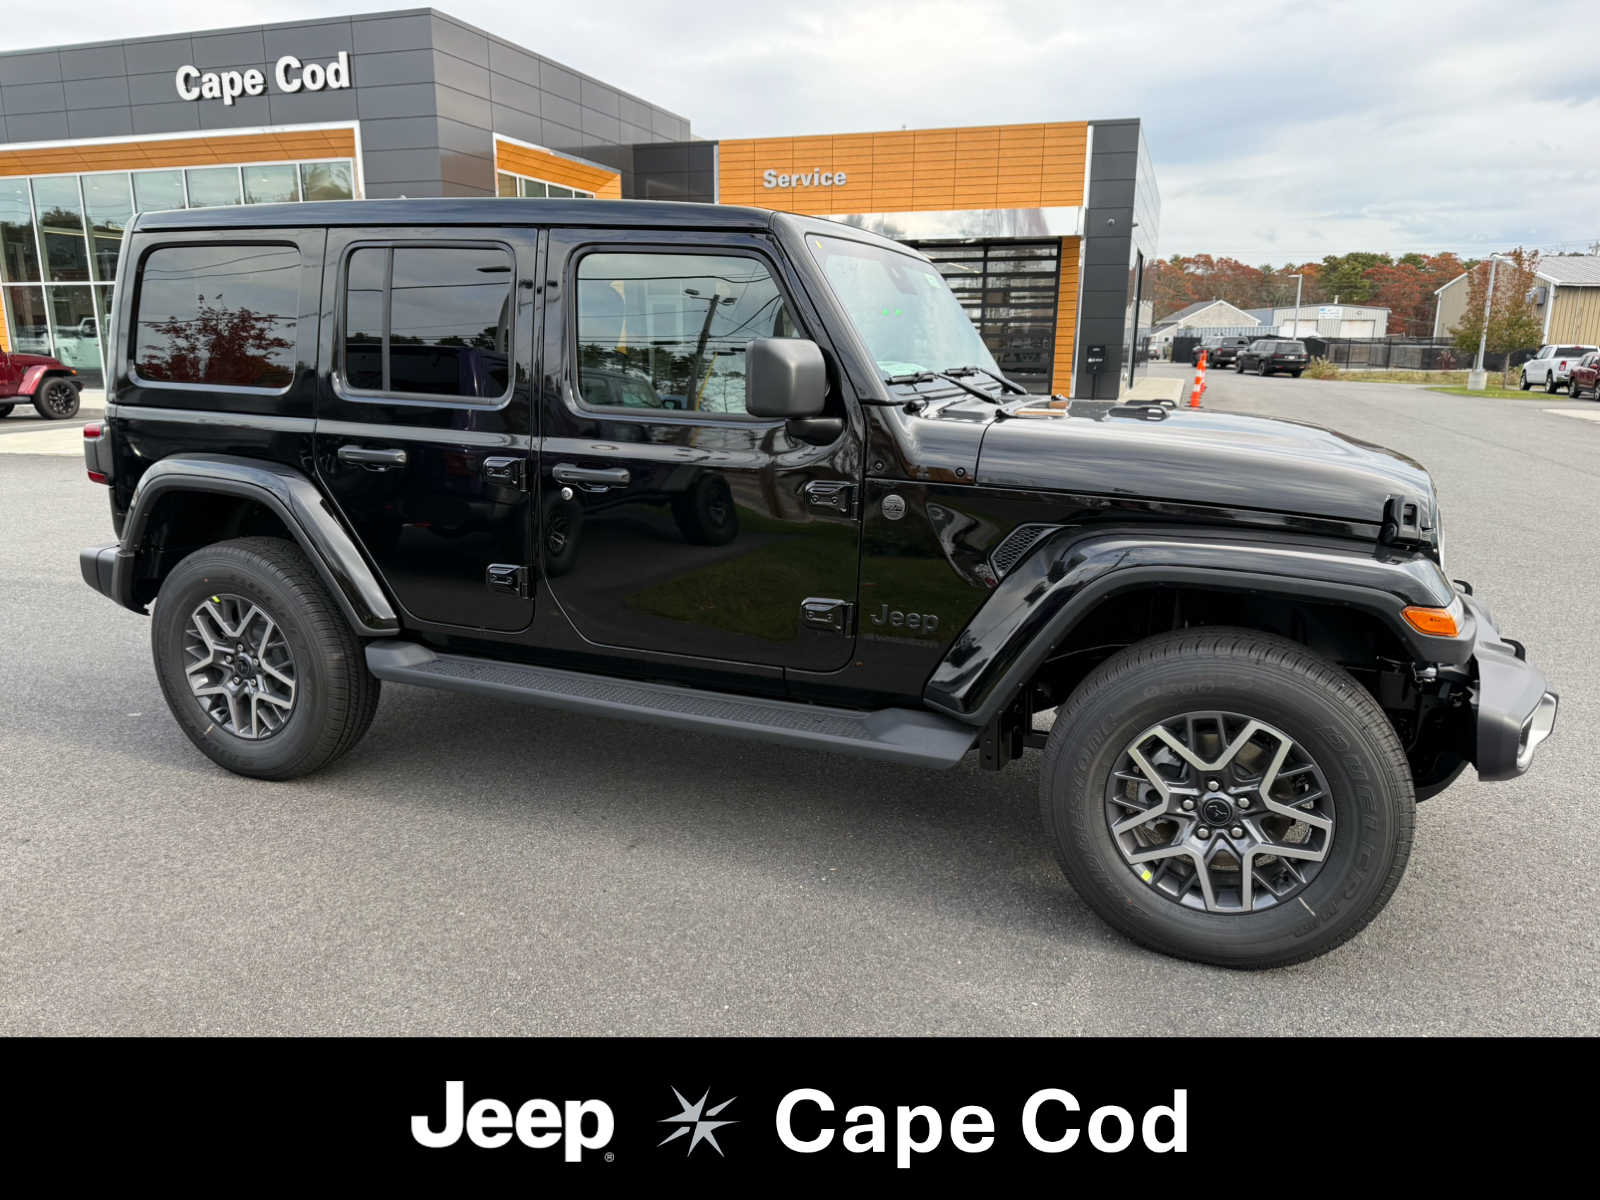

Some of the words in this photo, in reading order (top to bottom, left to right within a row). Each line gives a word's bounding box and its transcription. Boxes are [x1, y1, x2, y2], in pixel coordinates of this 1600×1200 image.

[175, 65, 266, 106] Cape
[275, 51, 351, 93] Cod
[762, 167, 847, 189] Service
[869, 603, 939, 635] Jeep
